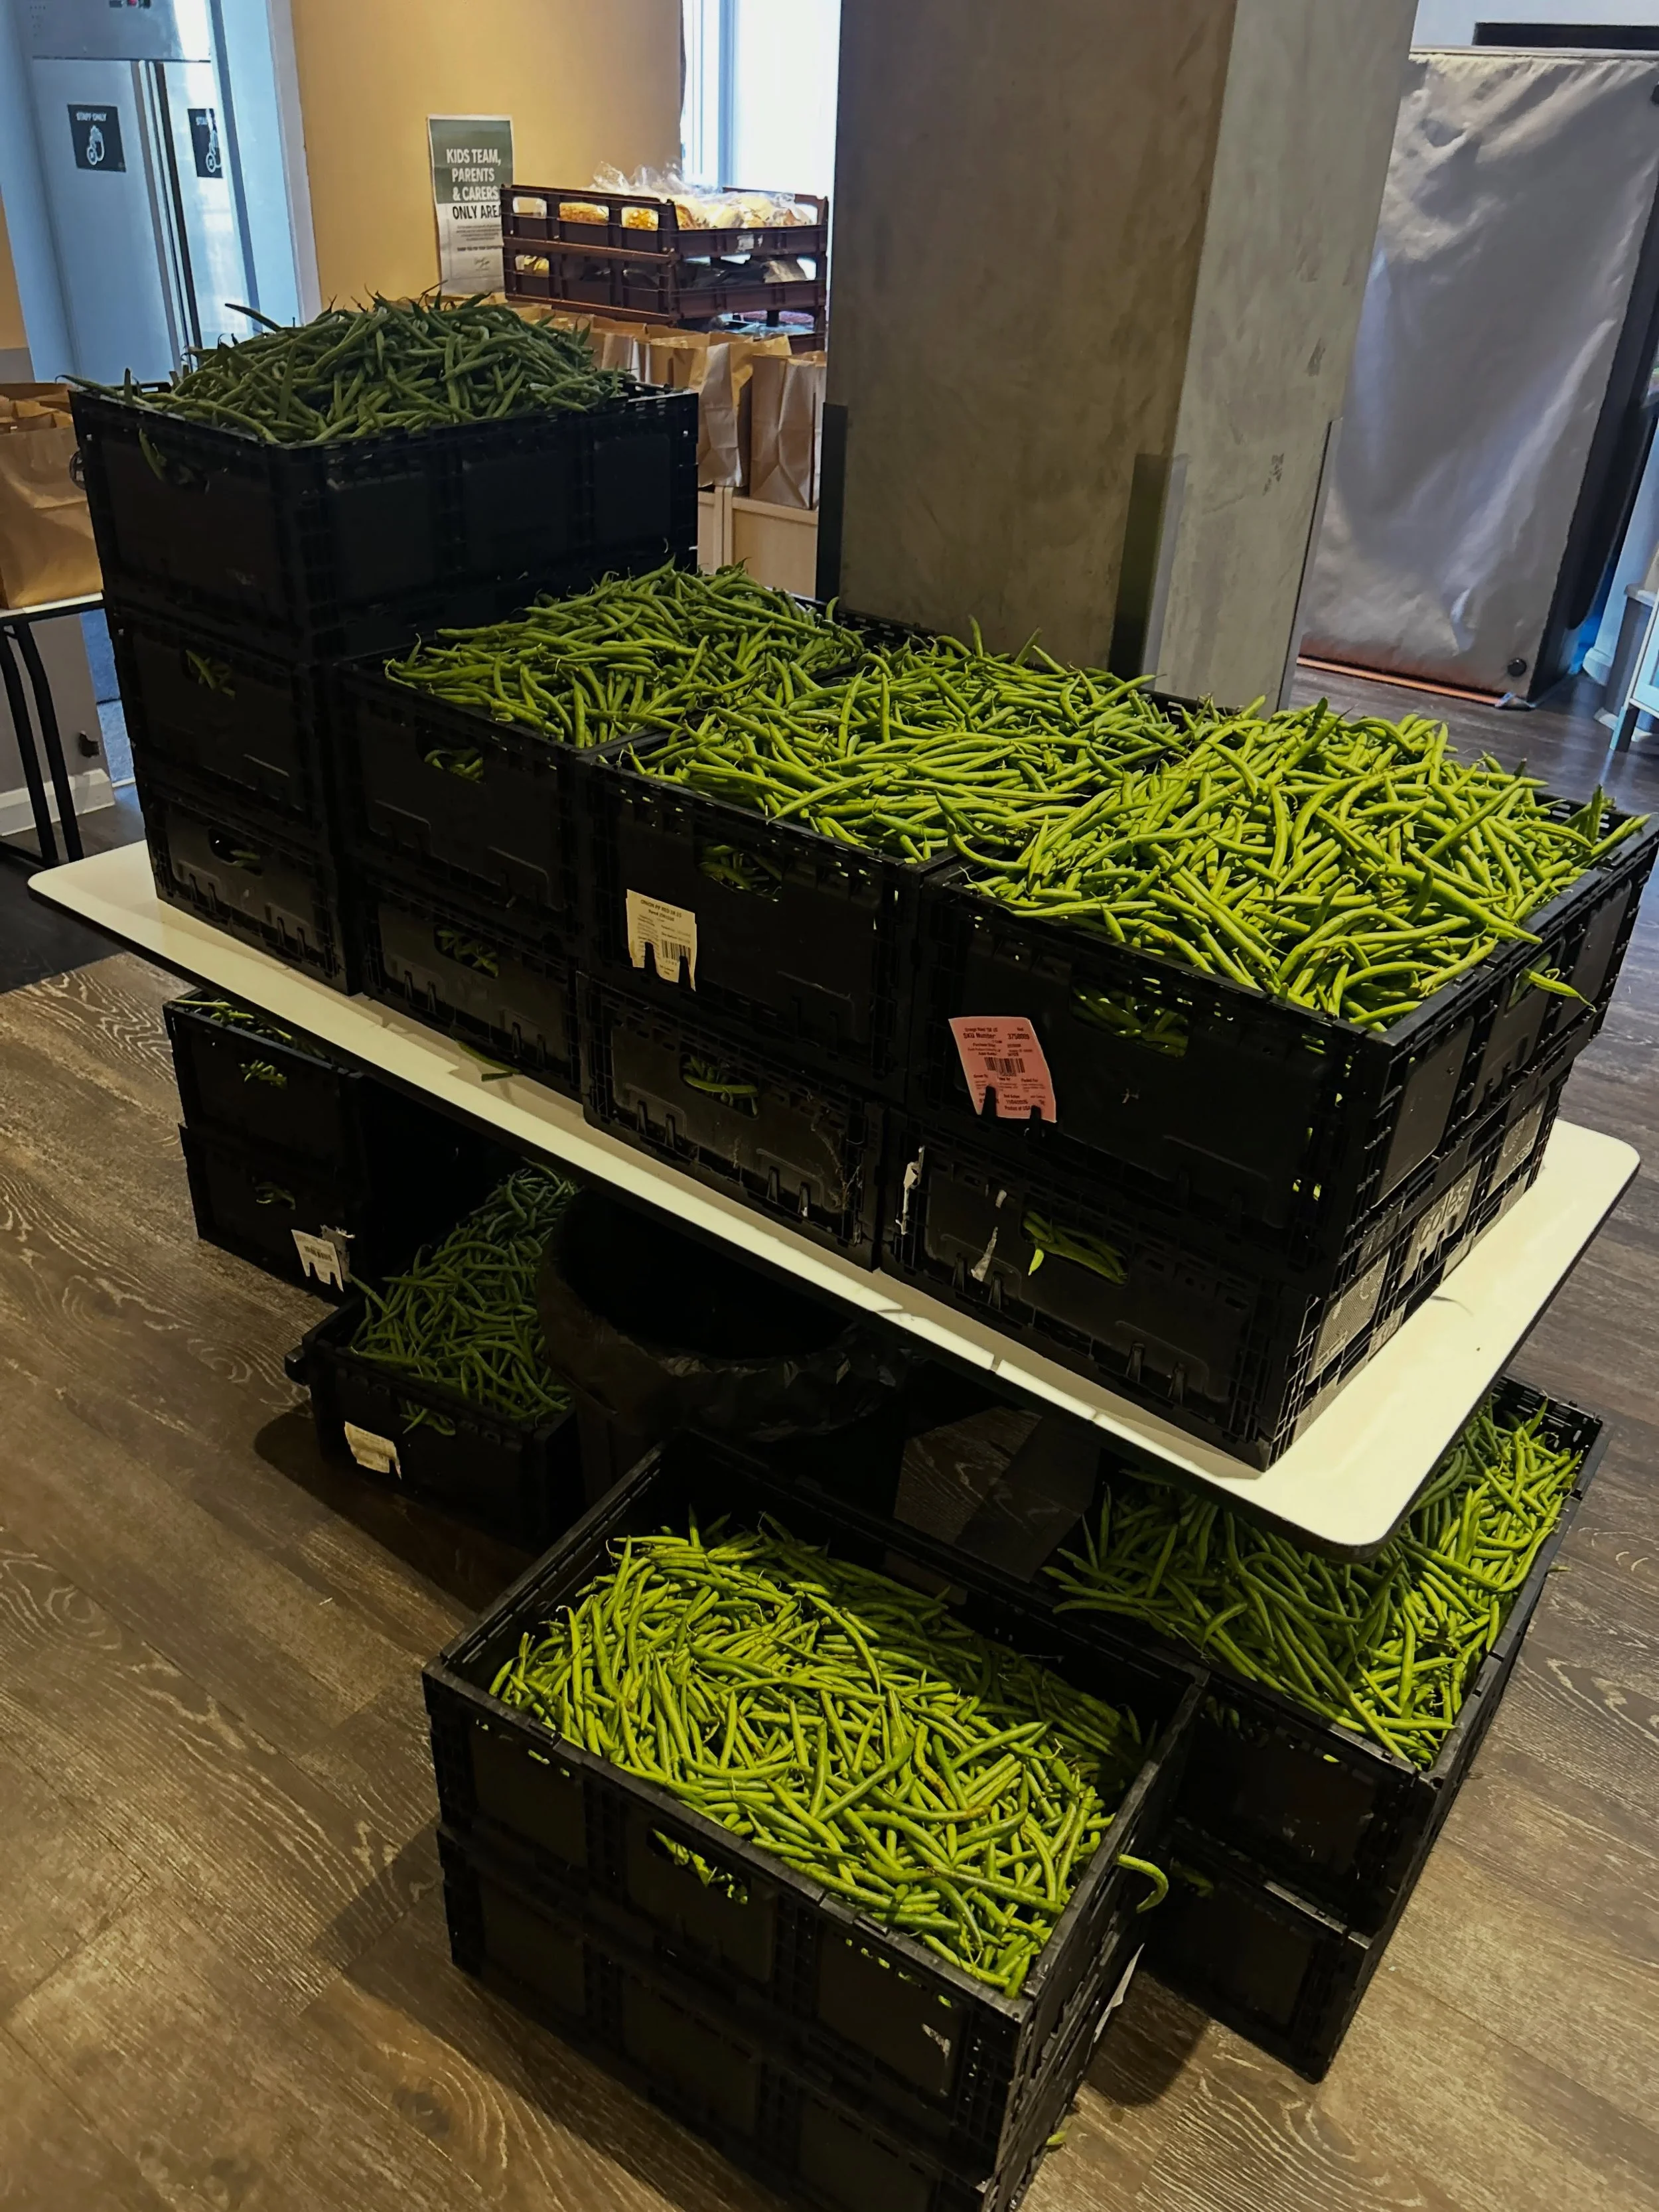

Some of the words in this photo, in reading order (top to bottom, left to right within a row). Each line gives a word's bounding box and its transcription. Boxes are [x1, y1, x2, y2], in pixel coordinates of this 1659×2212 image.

[446, 149, 470, 164] KIDS
[471, 149, 502, 167] TEAM,
[452, 167, 495, 183] PARENTS
[453, 186, 461, 201] &
[462, 186, 500, 201] CARERS
[453, 205, 477, 220] ONLY
[1419, 1178, 1472, 1244] coles
